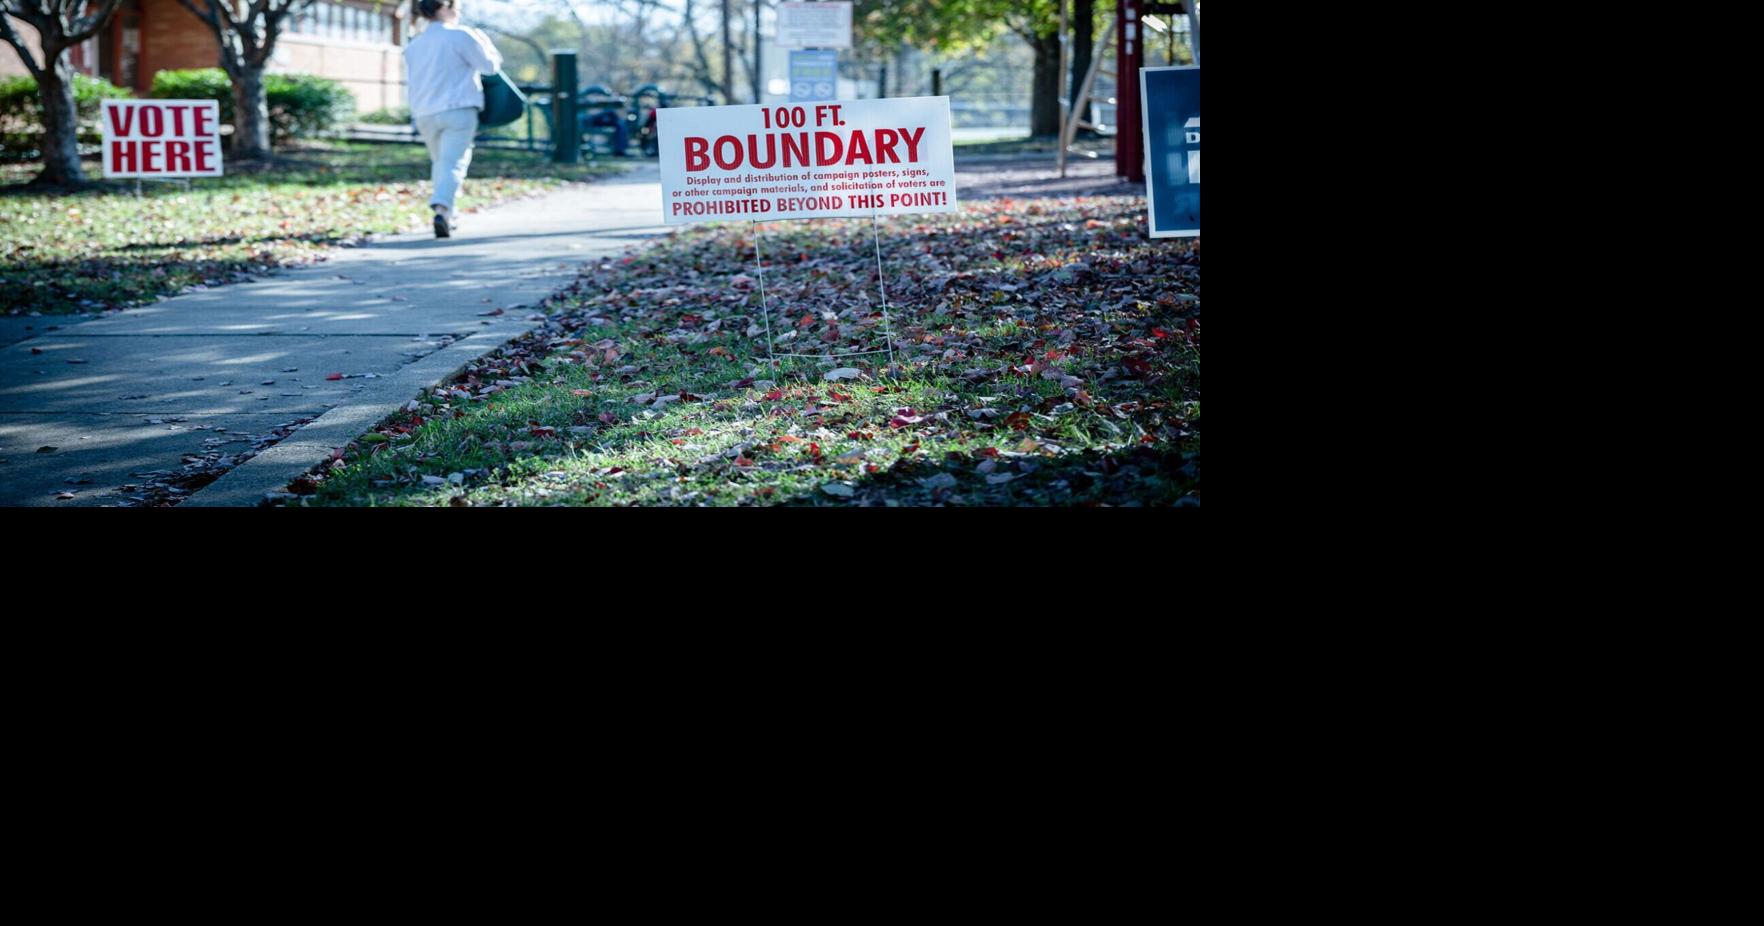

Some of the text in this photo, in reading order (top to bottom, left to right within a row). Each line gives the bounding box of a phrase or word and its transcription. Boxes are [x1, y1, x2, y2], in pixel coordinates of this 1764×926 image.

[108, 106, 214, 137] VOTE
[762, 105, 846, 128] 100 FT.
[112, 141, 215, 172] HERE
[684, 127, 926, 172] BOUNDARY
[685, 187, 710, 196] other
[712, 186, 759, 196] campaign
[761, 184, 808, 194] materials,
[810, 183, 828, 192] and
[831, 181, 883, 190] solicitation
[885, 180, 896, 188] of
[898, 179, 927, 187] voters
[687, 168, 929, 186] Display and distribution of campaign posters, signs,
[672, 192, 947, 216] PROHIBITED BEYOND THIS POINT!
